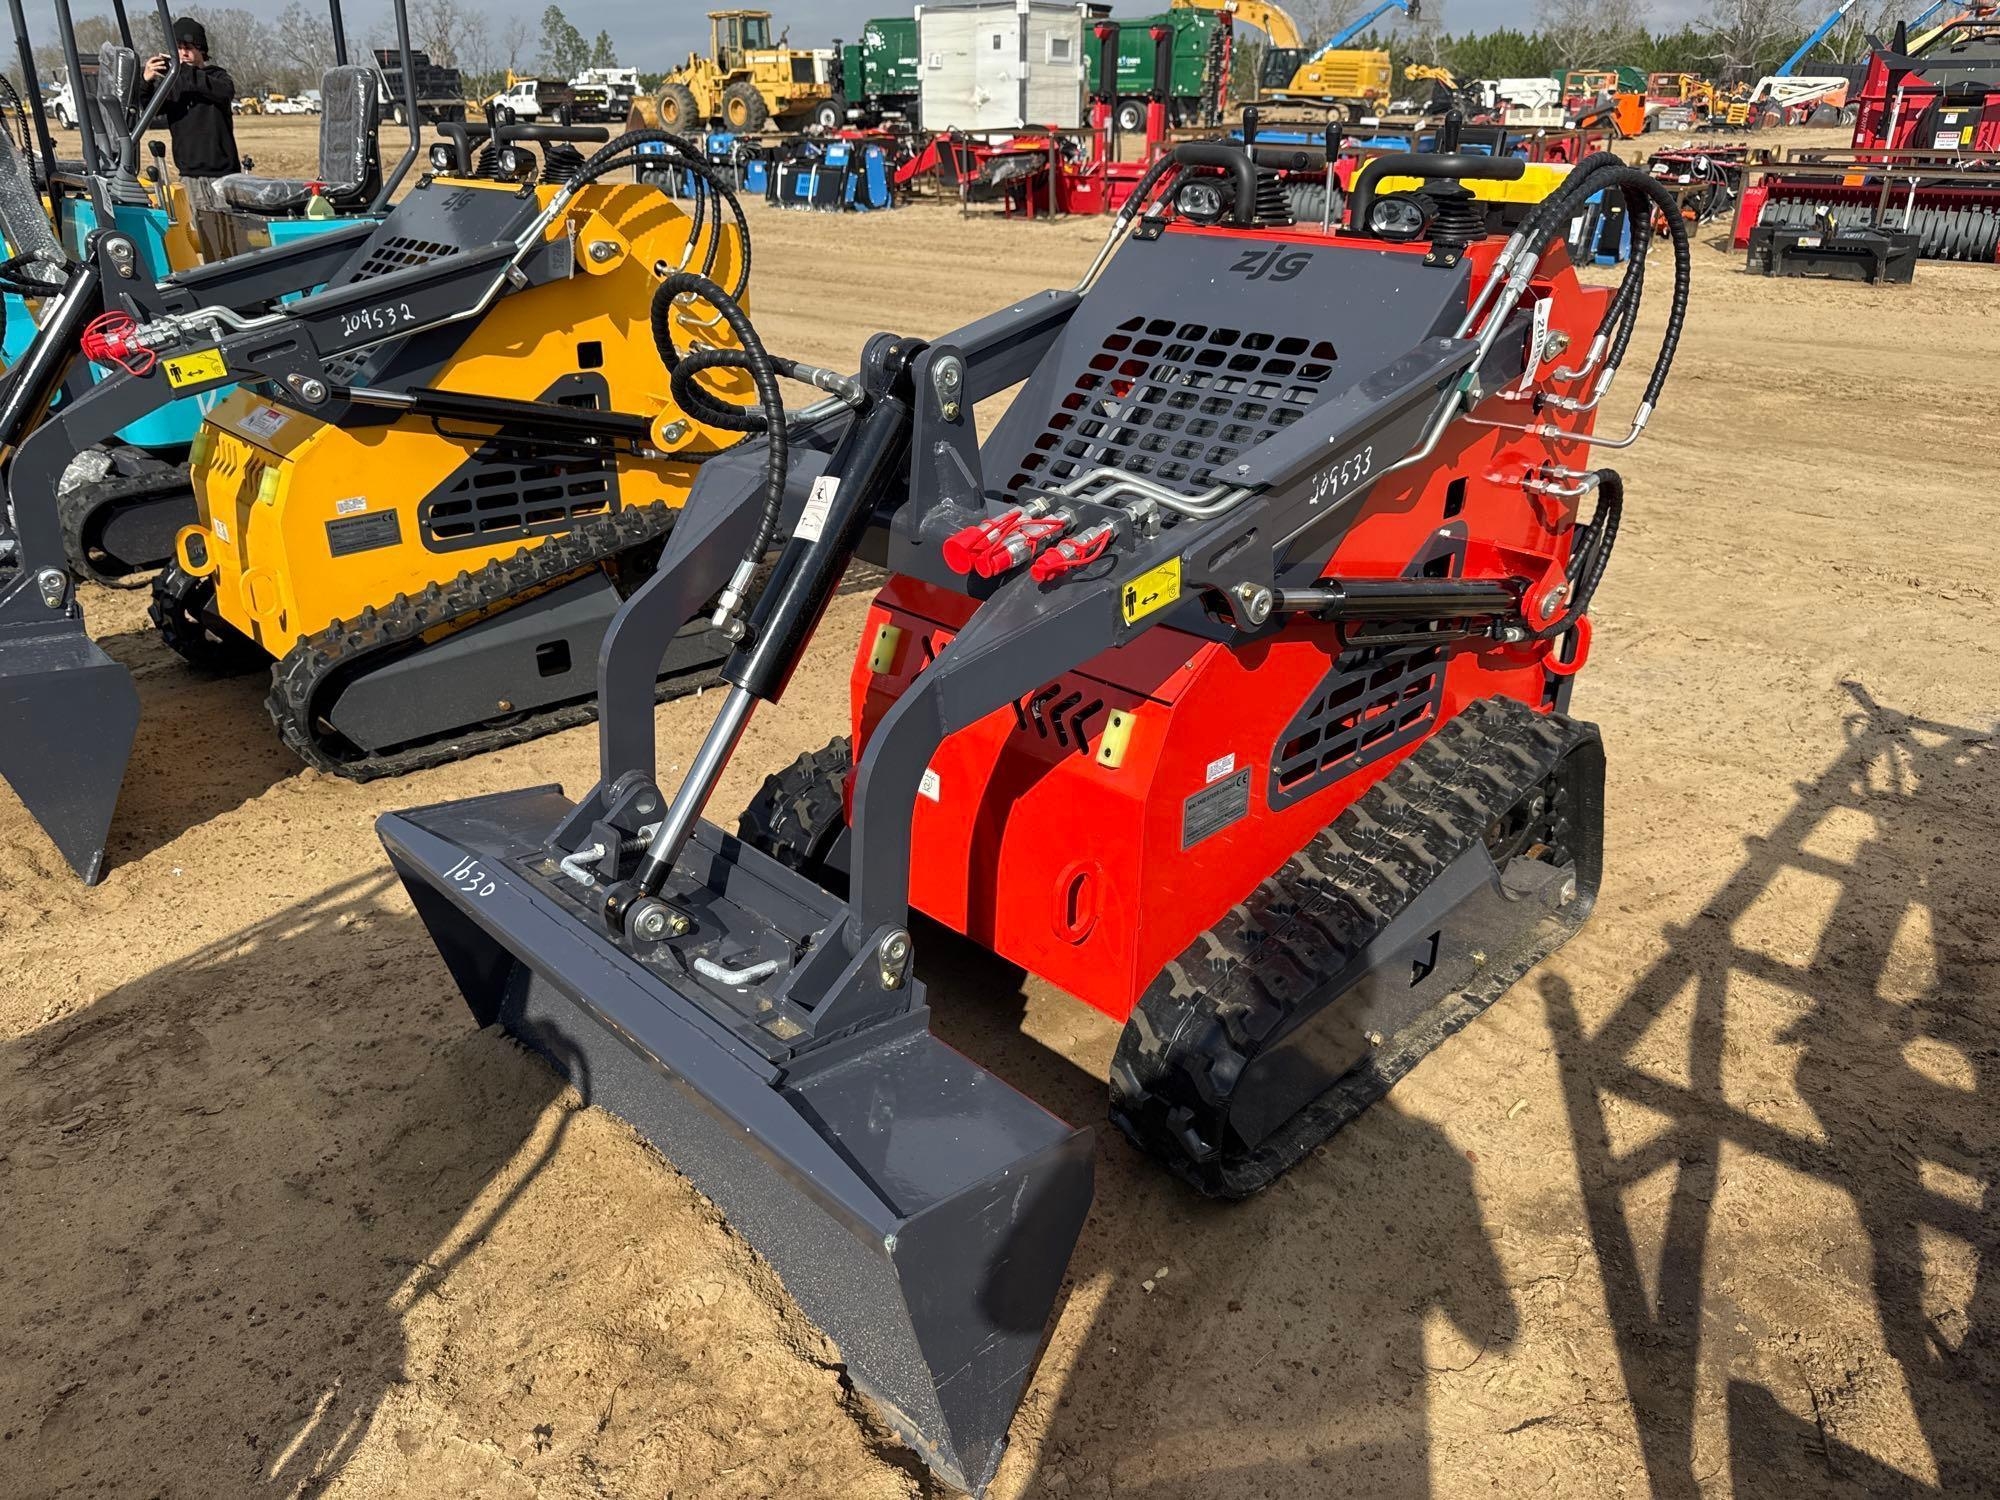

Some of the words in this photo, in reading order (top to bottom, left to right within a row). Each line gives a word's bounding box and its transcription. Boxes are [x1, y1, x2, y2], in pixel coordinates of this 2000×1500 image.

[1229, 244, 1314, 281] zjg
[341, 303, 416, 337] 209532
[1309, 446, 1372, 505] 209533
[443, 855, 496, 897] 1630
